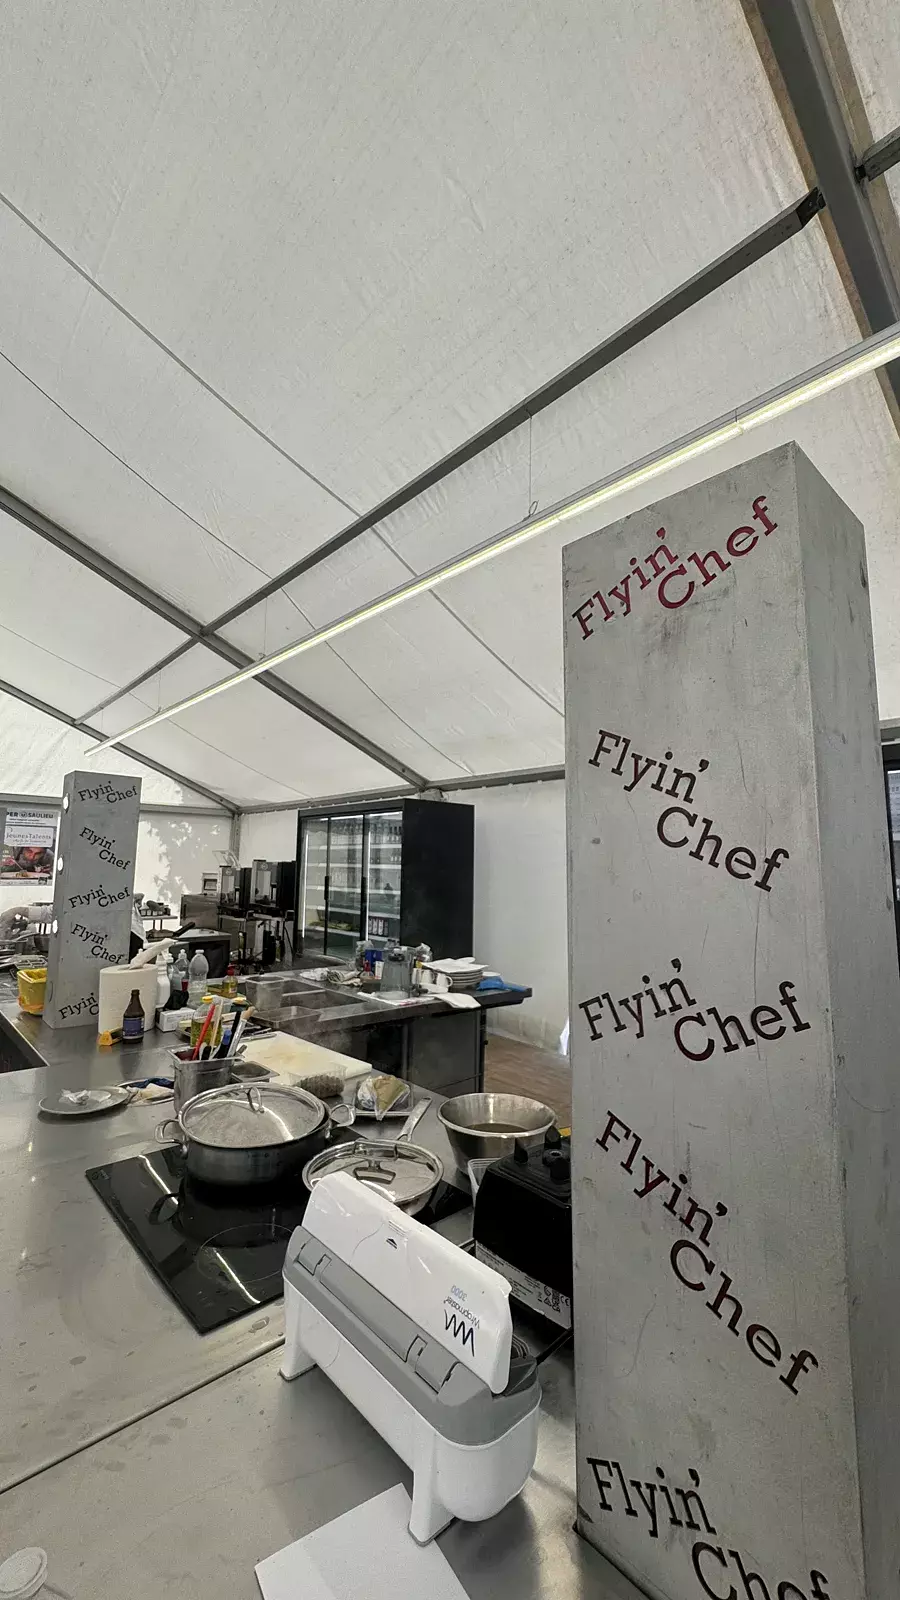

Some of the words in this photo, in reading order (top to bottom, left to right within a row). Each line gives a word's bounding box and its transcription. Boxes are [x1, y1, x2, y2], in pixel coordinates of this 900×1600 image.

[657, 495, 778, 610] Chef
[571, 526, 679, 641] Flyin'
[77, 780, 114, 802] Flyin'
[588, 729, 710, 804] Flyin'
[106, 785, 138, 804] Chef
[79, 826, 116, 850] Flyin'
[98, 849, 131, 870] Chef
[656, 806, 790, 892] Chef
[68, 884, 106, 909] Flyin'
[97, 886, 131, 908] Chef
[70, 923, 108, 946] Flyin'
[90, 945, 124, 965] Chef
[578, 957, 697, 1042] Flyin'
[673, 980, 811, 1062] Chef
[595, 1110, 728, 1248] Flyin'
[450, 1284, 468, 1302] 3000
[670, 1238, 819, 1396] Chef
[586, 1457, 718, 1539] Flyin'
